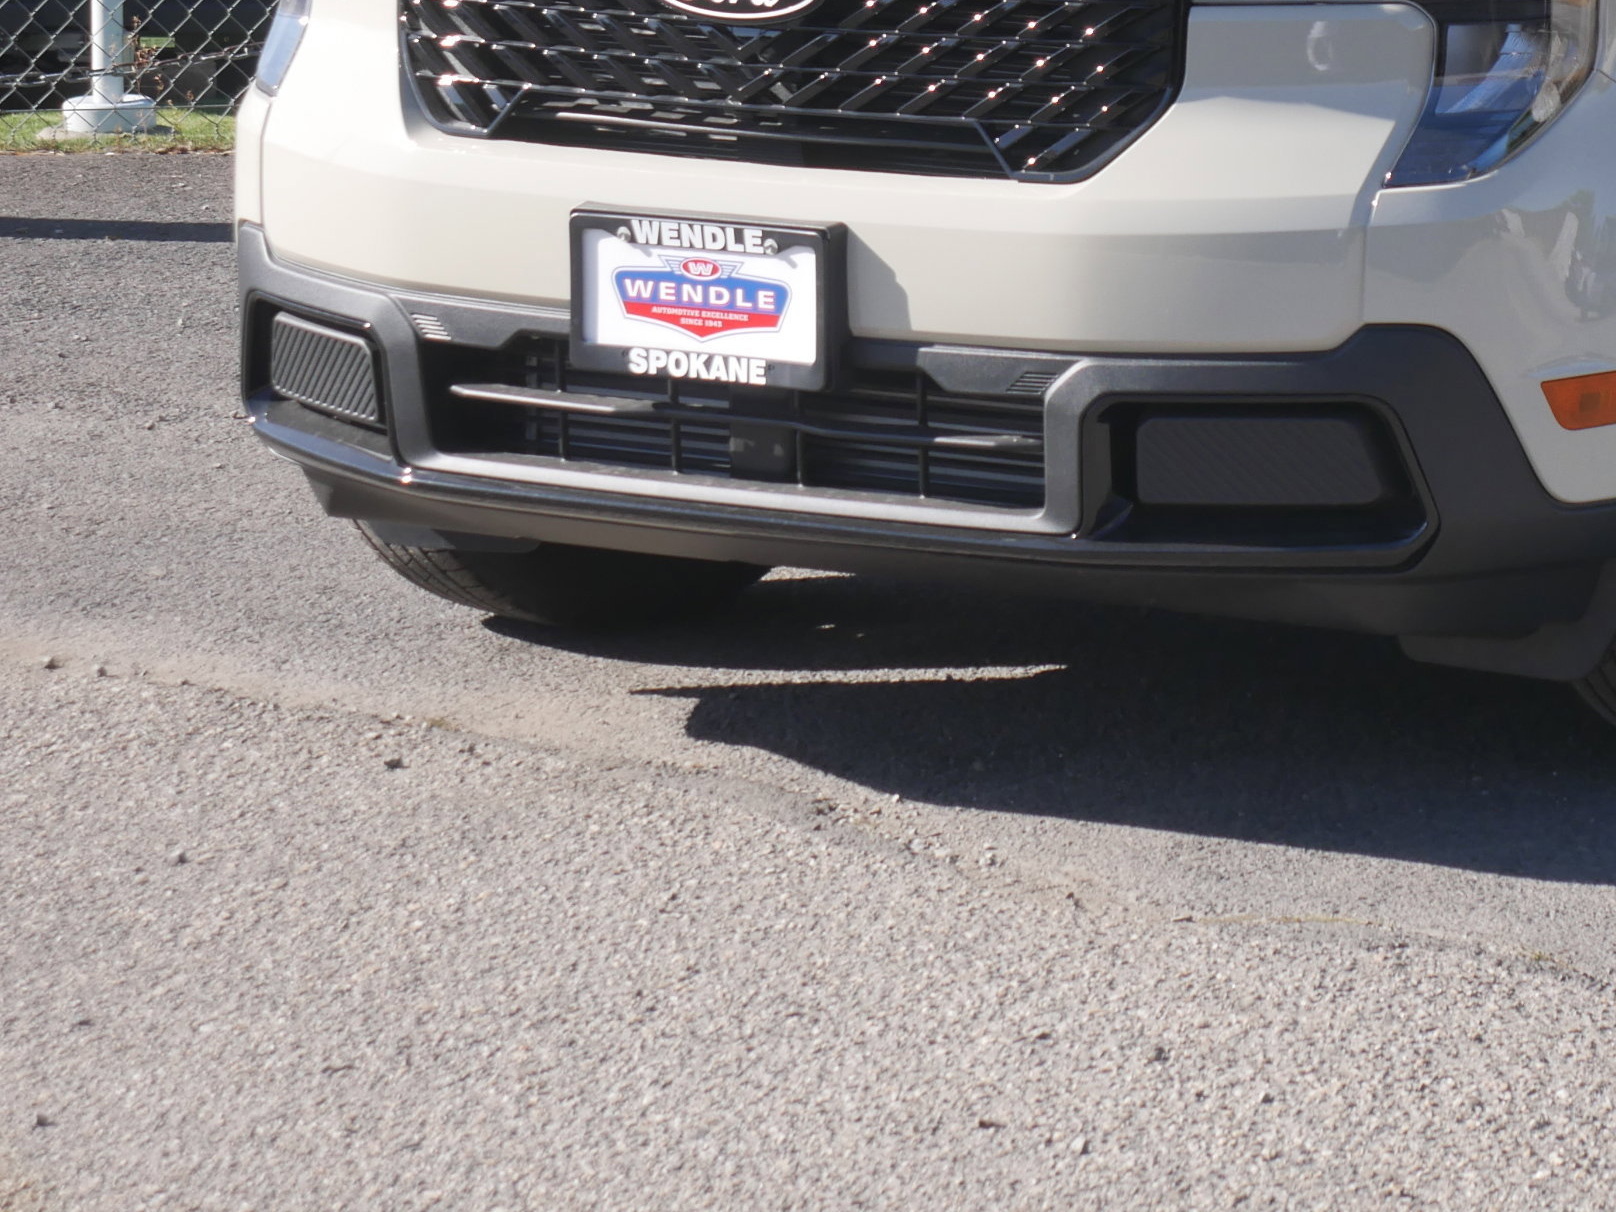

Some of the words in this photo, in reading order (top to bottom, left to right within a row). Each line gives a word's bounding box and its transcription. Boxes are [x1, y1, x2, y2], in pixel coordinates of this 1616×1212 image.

[631, 219, 765, 254] WENDLE
[624, 278, 775, 310] WENDLE
[651, 306, 700, 318] AUTOMOTIVE
[701, 310, 749, 322] EXCELLENCE
[628, 347, 767, 385] SPOKANE
